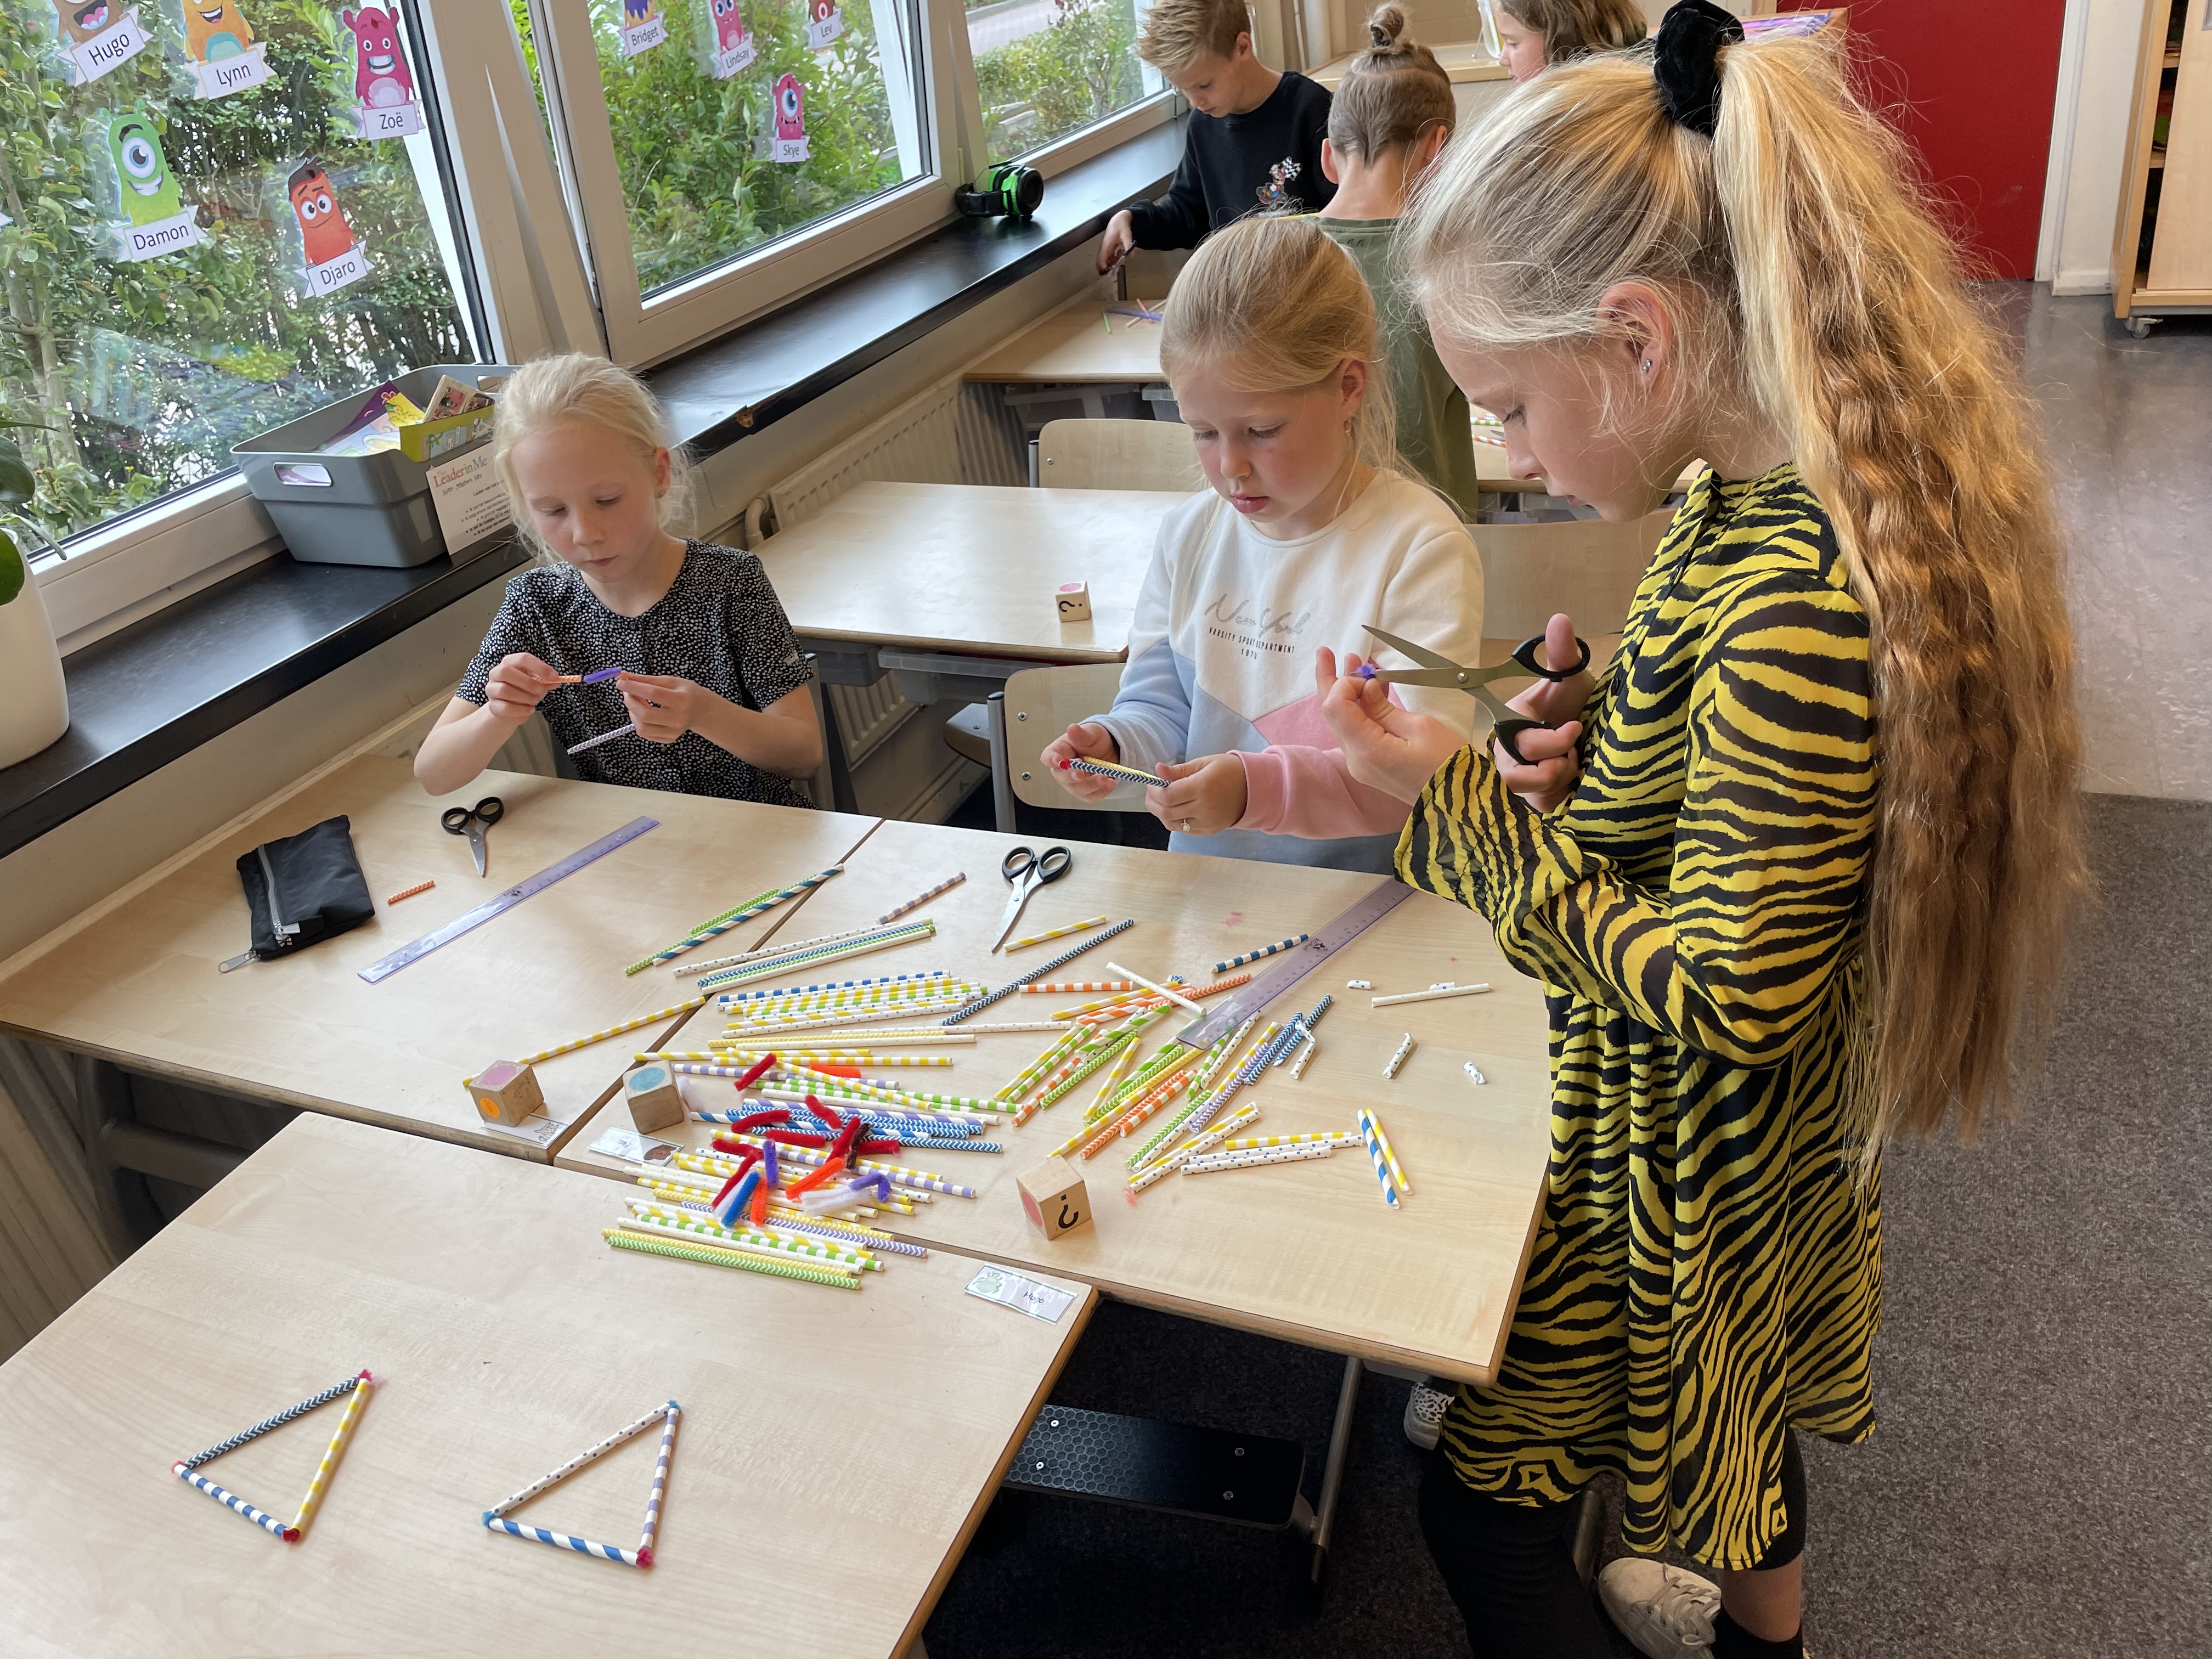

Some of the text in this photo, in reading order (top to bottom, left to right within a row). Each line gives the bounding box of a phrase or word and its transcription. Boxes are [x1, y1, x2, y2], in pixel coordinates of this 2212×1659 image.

[631, 26, 659, 46] Bridget
[821, 24, 832, 37] Lev
[88, 33, 130, 66] Hugo
[725, 48, 750, 69] Lindsay
[216, 64, 251, 87] Lynn
[380, 111, 404, 131] Zoë
[782, 144, 800, 157] Skye
[133, 223, 190, 251] Damon
[320, 261, 356, 287] Djaro
[433, 456, 487, 488] Leader in Me
[1209, 627, 1236, 641] VARSITY
[1238, 635, 1255, 646] SPORT
[1240, 648, 1257, 659] 1970
[1023, 1291, 1045, 1304] Hugo
